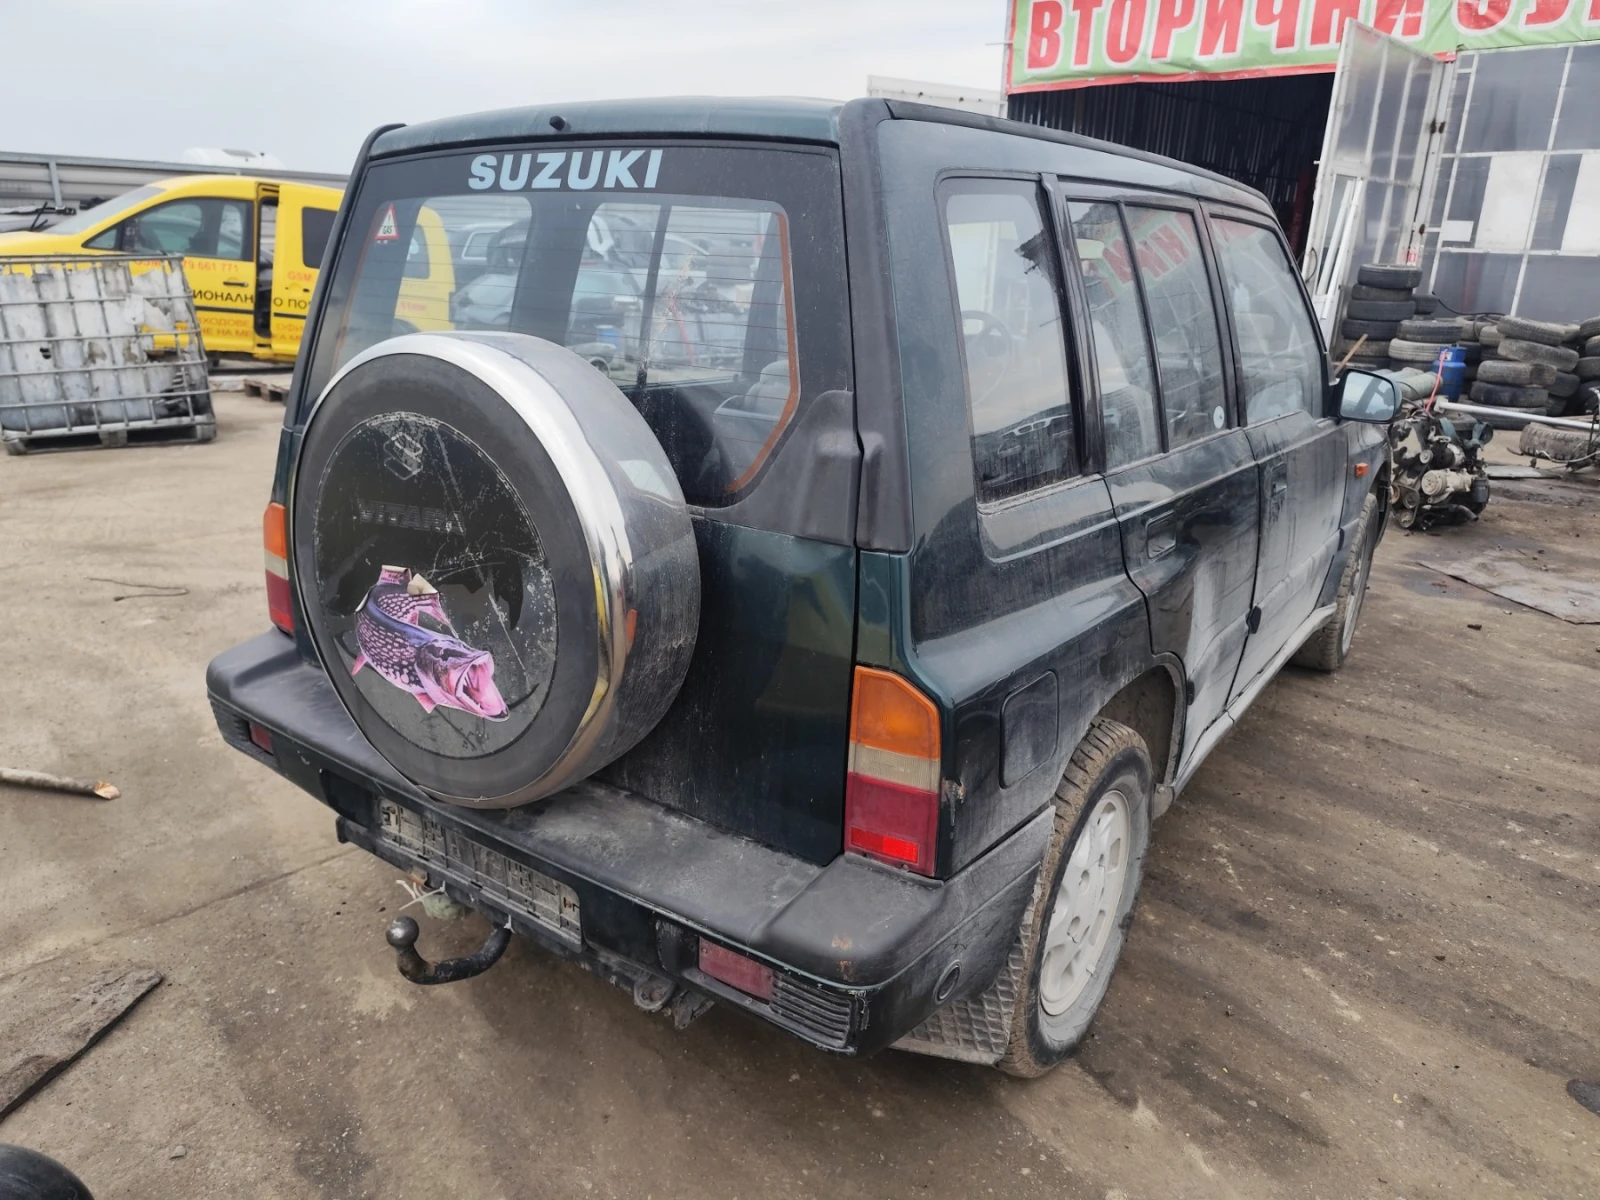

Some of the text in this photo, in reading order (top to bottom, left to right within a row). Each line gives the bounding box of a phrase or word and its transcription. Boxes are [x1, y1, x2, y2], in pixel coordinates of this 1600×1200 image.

[468, 149, 664, 191] SUZUKI
[382, 225, 393, 234] GAS
[287, 271, 312, 281] GSM
[193, 289, 254, 304] ИОНАЛН
[288, 298, 313, 310] ПО
[357, 498, 466, 535] VITARA
